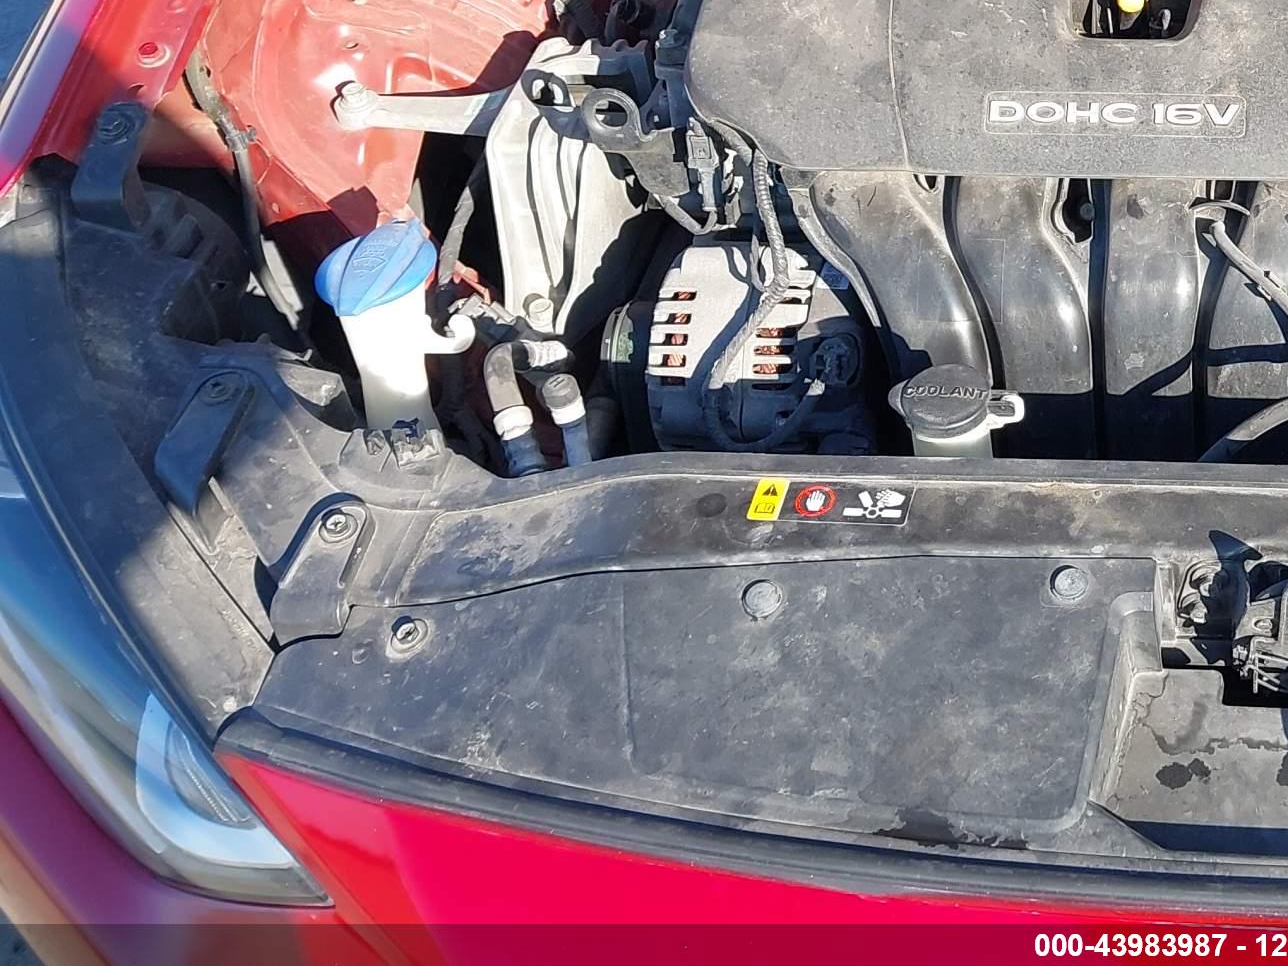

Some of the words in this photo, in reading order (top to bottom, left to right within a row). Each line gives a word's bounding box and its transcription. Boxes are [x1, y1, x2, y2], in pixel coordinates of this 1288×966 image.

[988, 101, 1137, 125] DOHC
[1152, 101, 1241, 126] 16V
[903, 385, 988, 400] COOLANT
